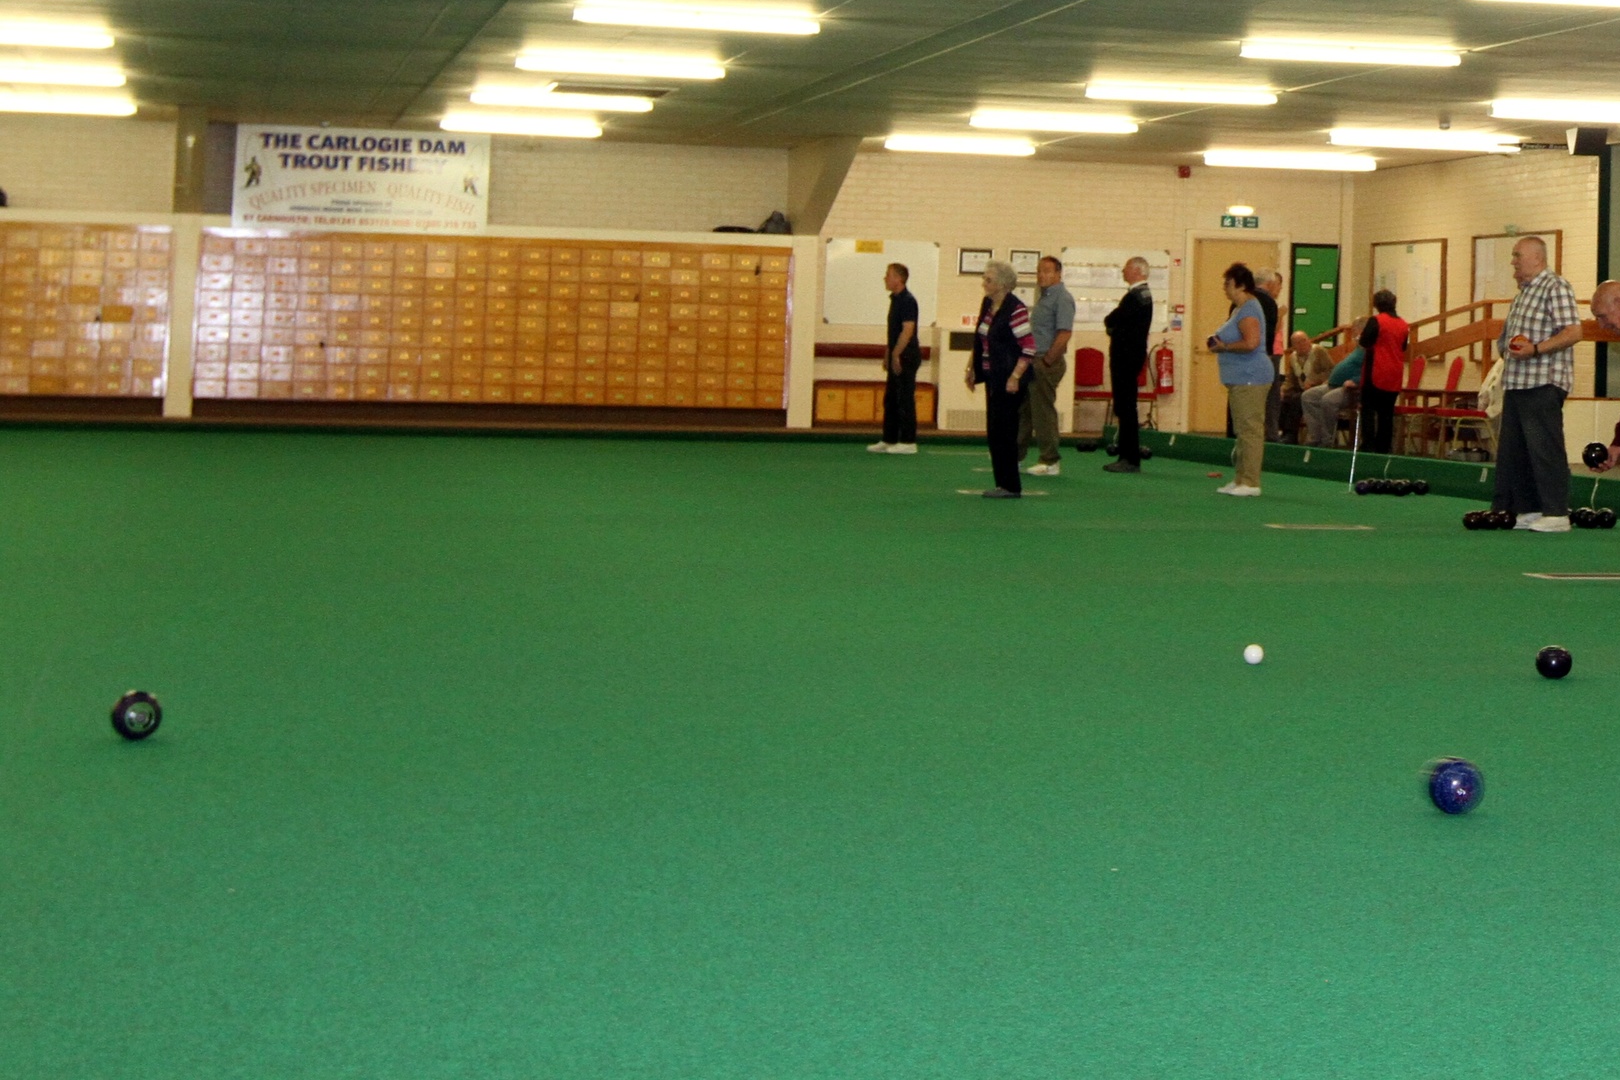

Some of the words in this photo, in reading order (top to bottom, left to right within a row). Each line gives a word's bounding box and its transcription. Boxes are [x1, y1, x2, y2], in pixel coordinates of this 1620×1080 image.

[262, 132, 302, 149] THE
[306, 133, 413, 154] CARLOGIE
[417, 138, 467, 156] DAM
[279, 153, 353, 171] TROUT
